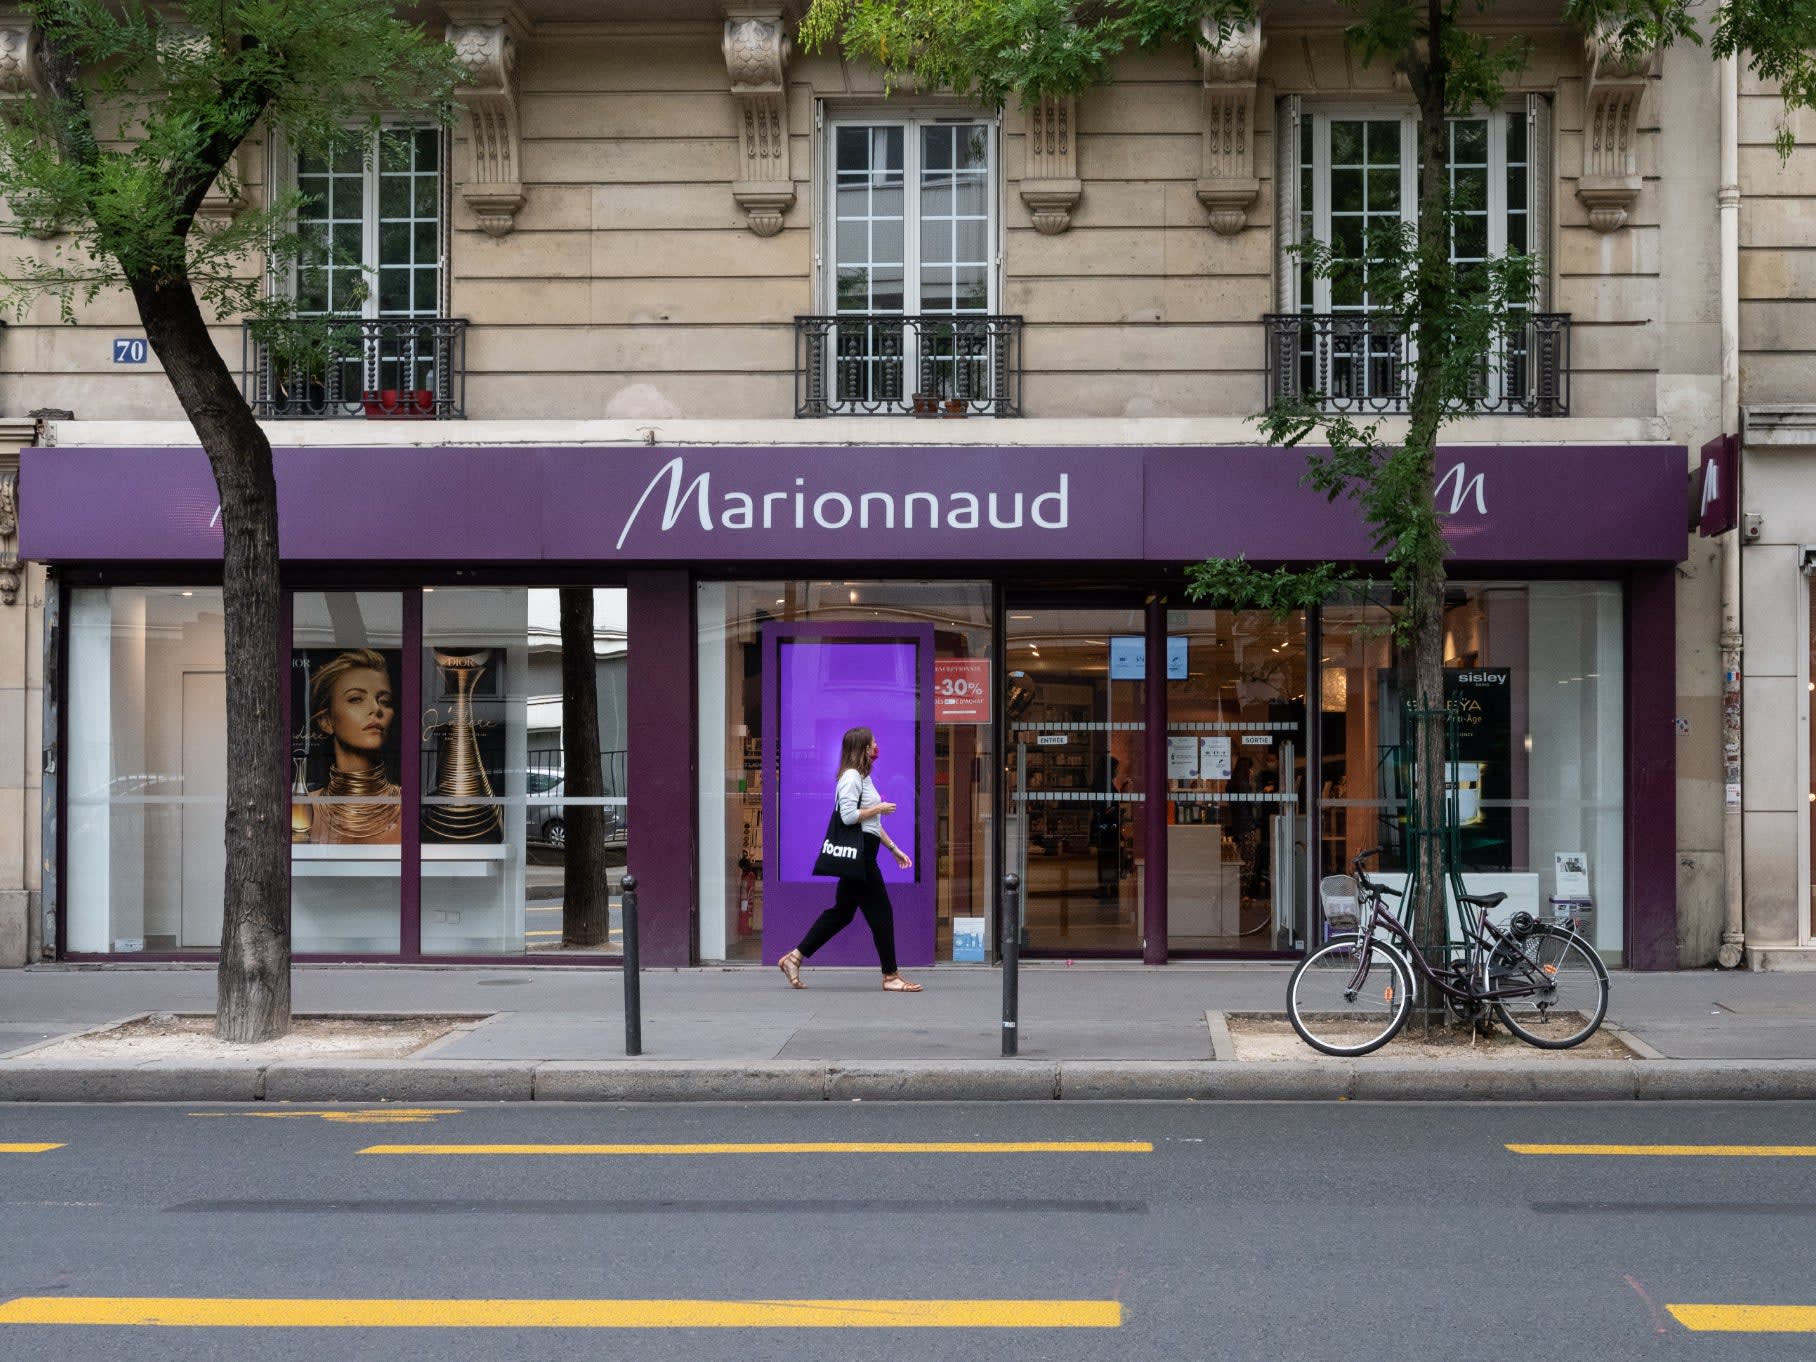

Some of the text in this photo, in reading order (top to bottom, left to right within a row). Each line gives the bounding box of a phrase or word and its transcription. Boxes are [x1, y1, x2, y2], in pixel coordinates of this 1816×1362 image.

[117, 340, 144, 361] 70
[615, 456, 1069, 550] Marionnaud
[292, 658, 311, 668] IOR
[448, 658, 474, 667] DIOR
[935, 678, 983, 696] -30%
[1458, 672, 1507, 685] sisley
[822, 839, 857, 859] foam
